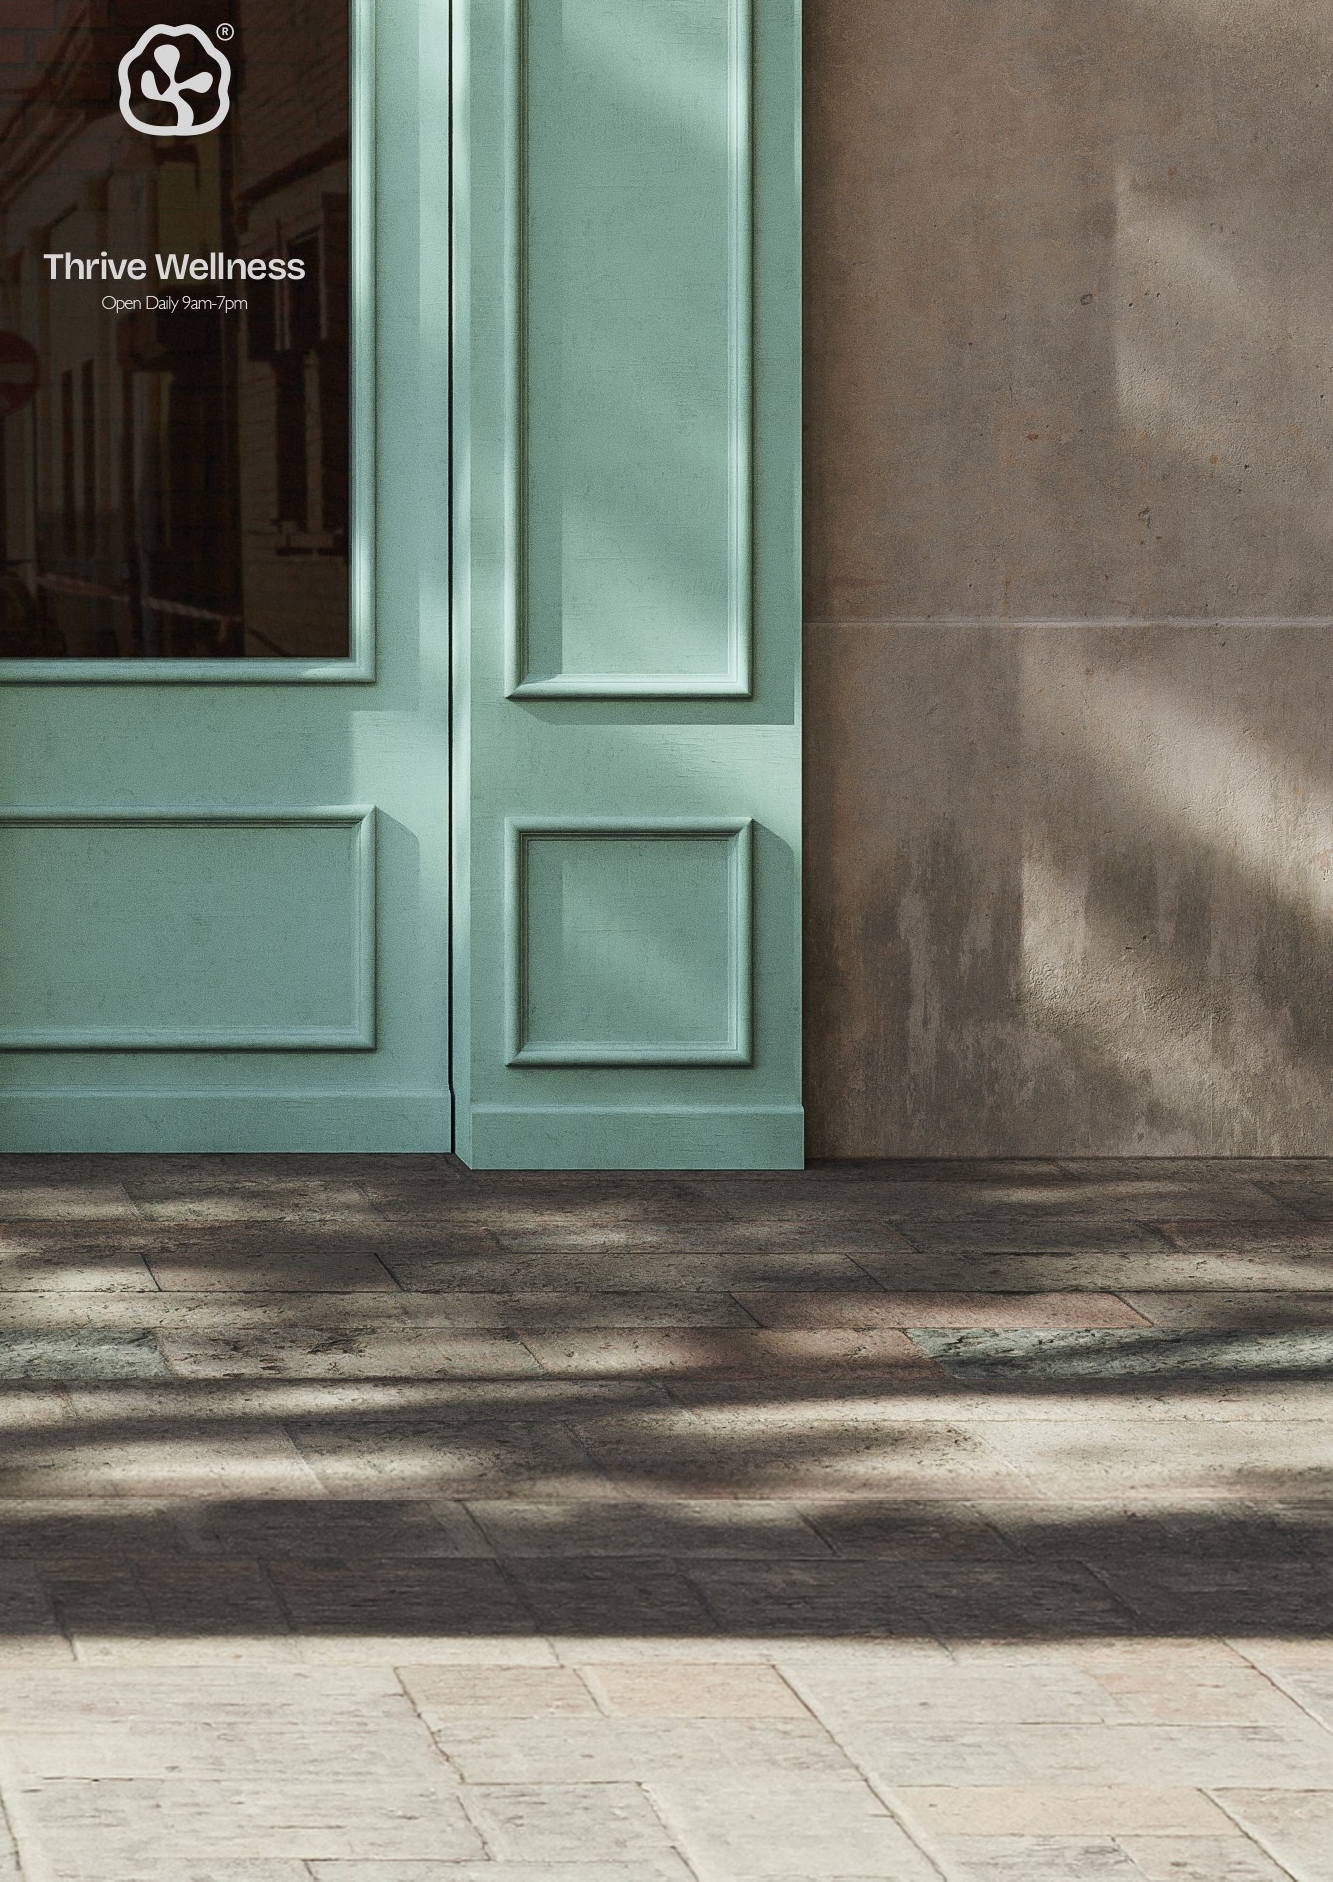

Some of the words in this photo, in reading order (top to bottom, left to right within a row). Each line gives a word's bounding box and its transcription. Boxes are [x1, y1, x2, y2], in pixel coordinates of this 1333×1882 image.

[43, 251, 147, 280] Thrive
[155, 251, 306, 280] Wellness
[101, 296, 142, 313] Open
[145, 295, 179, 313] Daily
[182, 295, 248, 313] 9am-7pm
